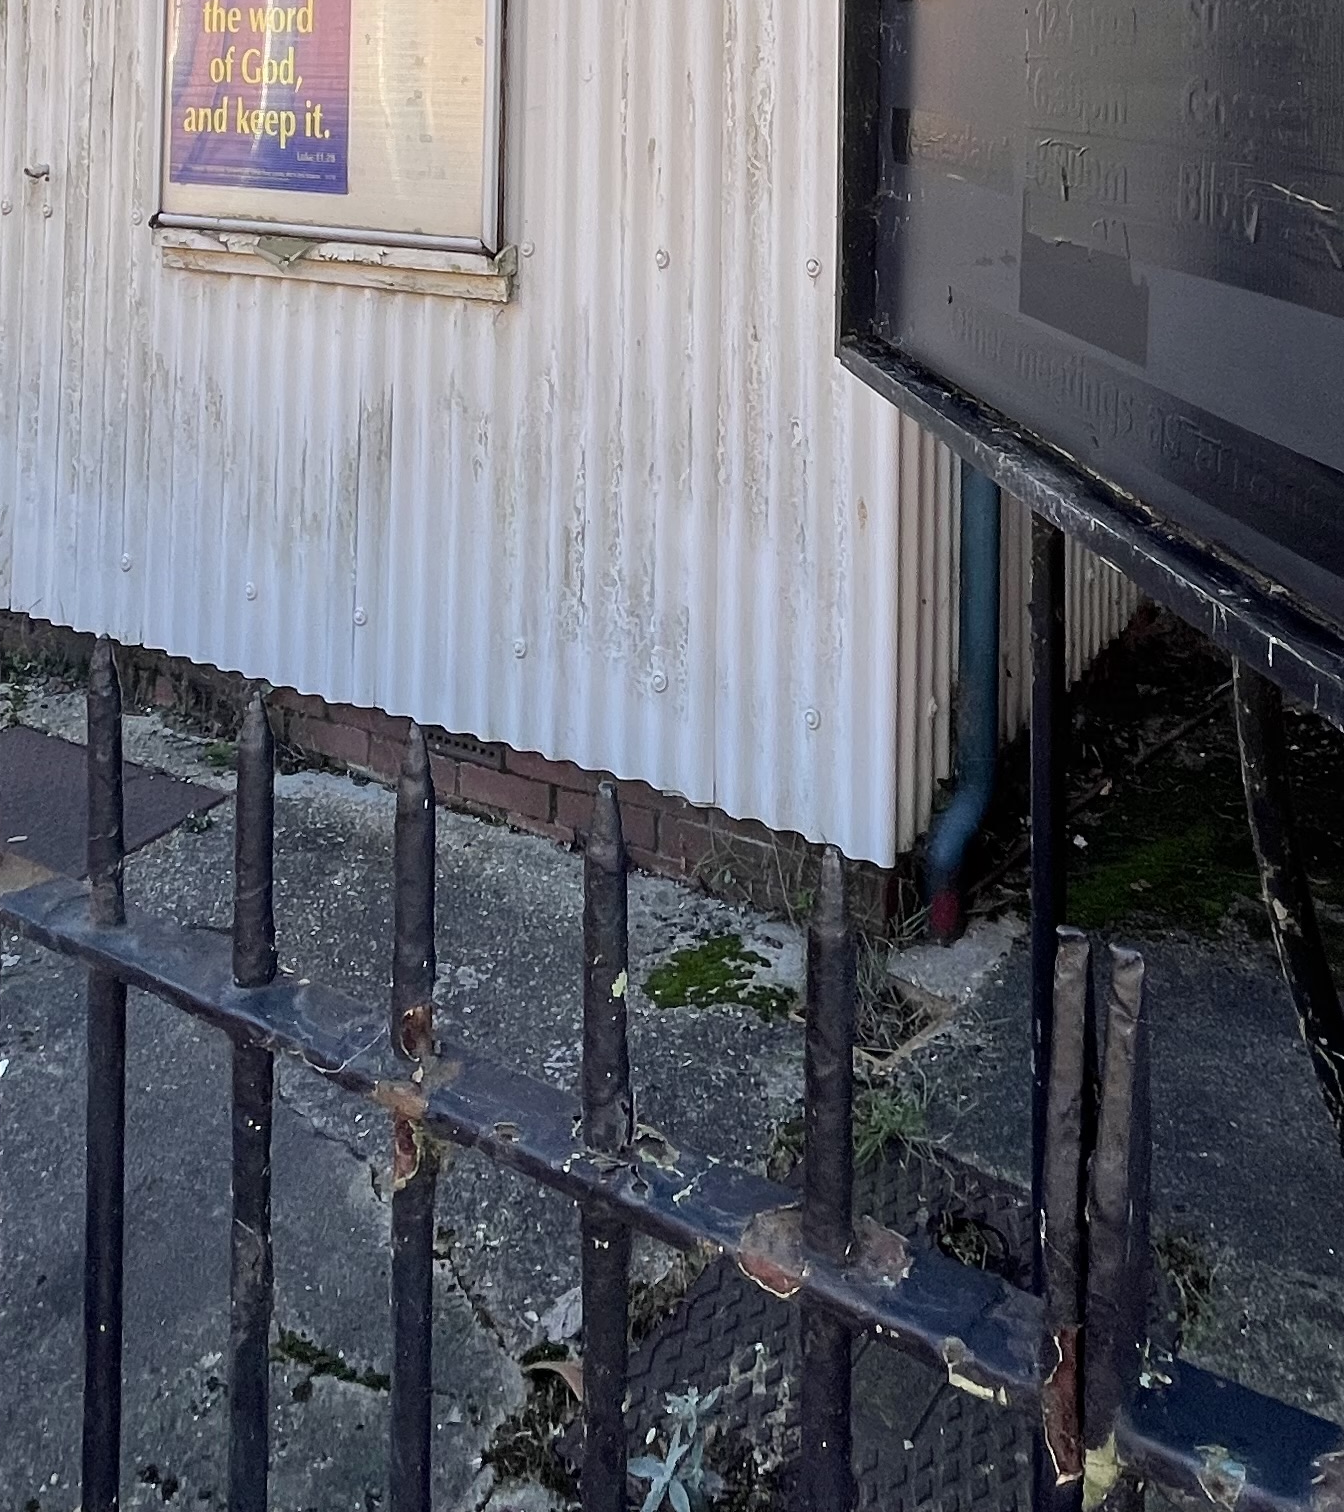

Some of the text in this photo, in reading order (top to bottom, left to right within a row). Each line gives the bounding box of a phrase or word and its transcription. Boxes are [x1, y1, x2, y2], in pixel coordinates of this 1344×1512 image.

[209, 45, 304, 95] of God,
[183, 97, 331, 149] and keep it.
